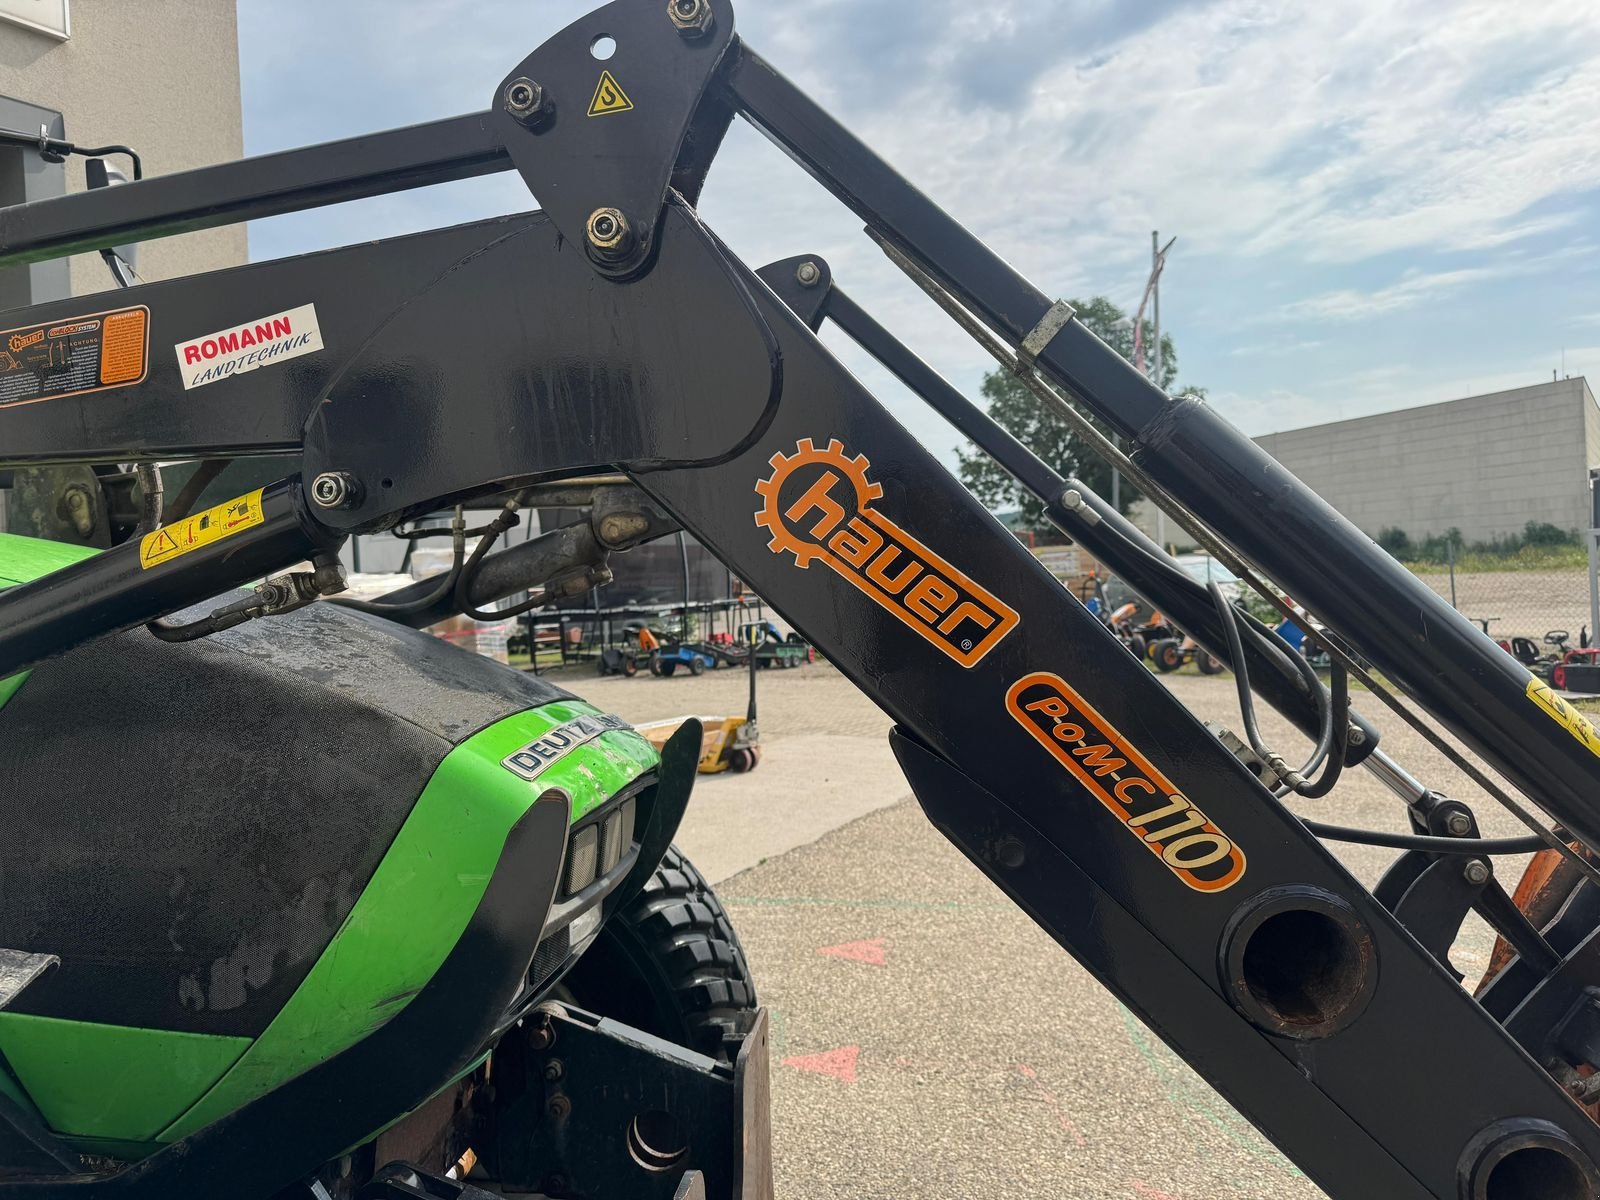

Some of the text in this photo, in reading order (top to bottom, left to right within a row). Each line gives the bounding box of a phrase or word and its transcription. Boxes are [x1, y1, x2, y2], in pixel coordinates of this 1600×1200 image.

[184, 316, 292, 365] ROMANN
[192, 331, 313, 386] LANDTECHNIK
[784, 470, 996, 635] hauer
[1126, 793, 1232, 870] 110
